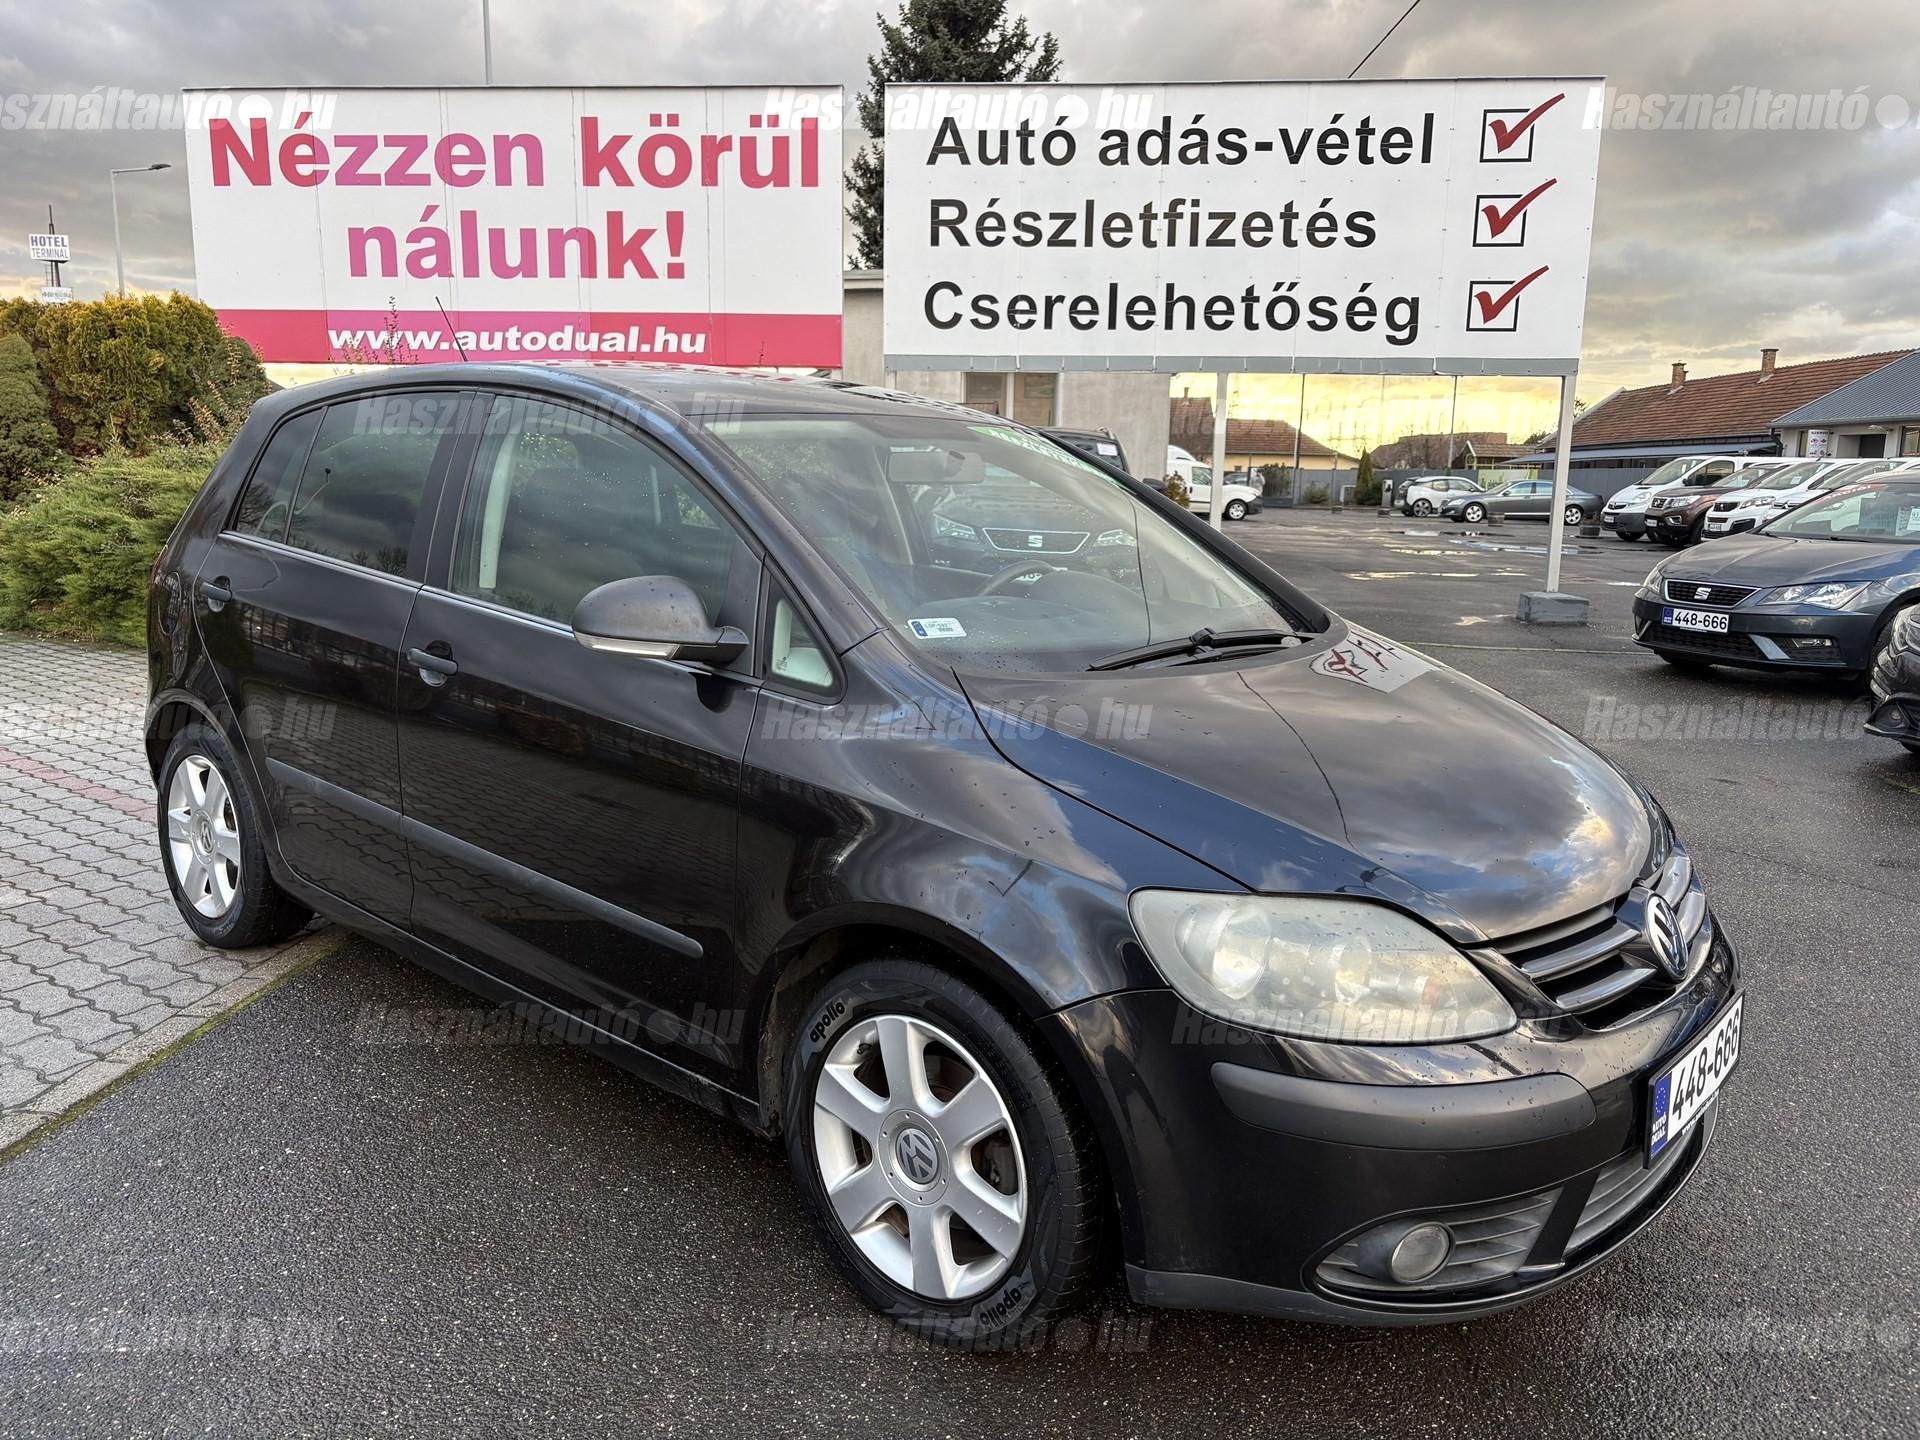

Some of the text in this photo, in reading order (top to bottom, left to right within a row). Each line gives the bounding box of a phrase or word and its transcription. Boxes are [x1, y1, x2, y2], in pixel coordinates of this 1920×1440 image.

[210, 112, 819, 188] Nézzen körül
[926, 112, 1434, 167] Autó adás-vétel
[30, 235, 68, 248] HOTEL
[349, 206, 686, 280] nálunk!
[930, 197, 1377, 249] Részletfizetés
[32, 248, 69, 258] TERMINAL
[924, 279, 1421, 345] Cserelehetőség
[328, 324, 706, 354] www.autodual.hu
[1675, 611, 1727, 630] 448-666
[810, 1000, 846, 1043] apollo
[1672, 1007, 1740, 1121] 448-666
[980, 1287, 1022, 1328] apollo
